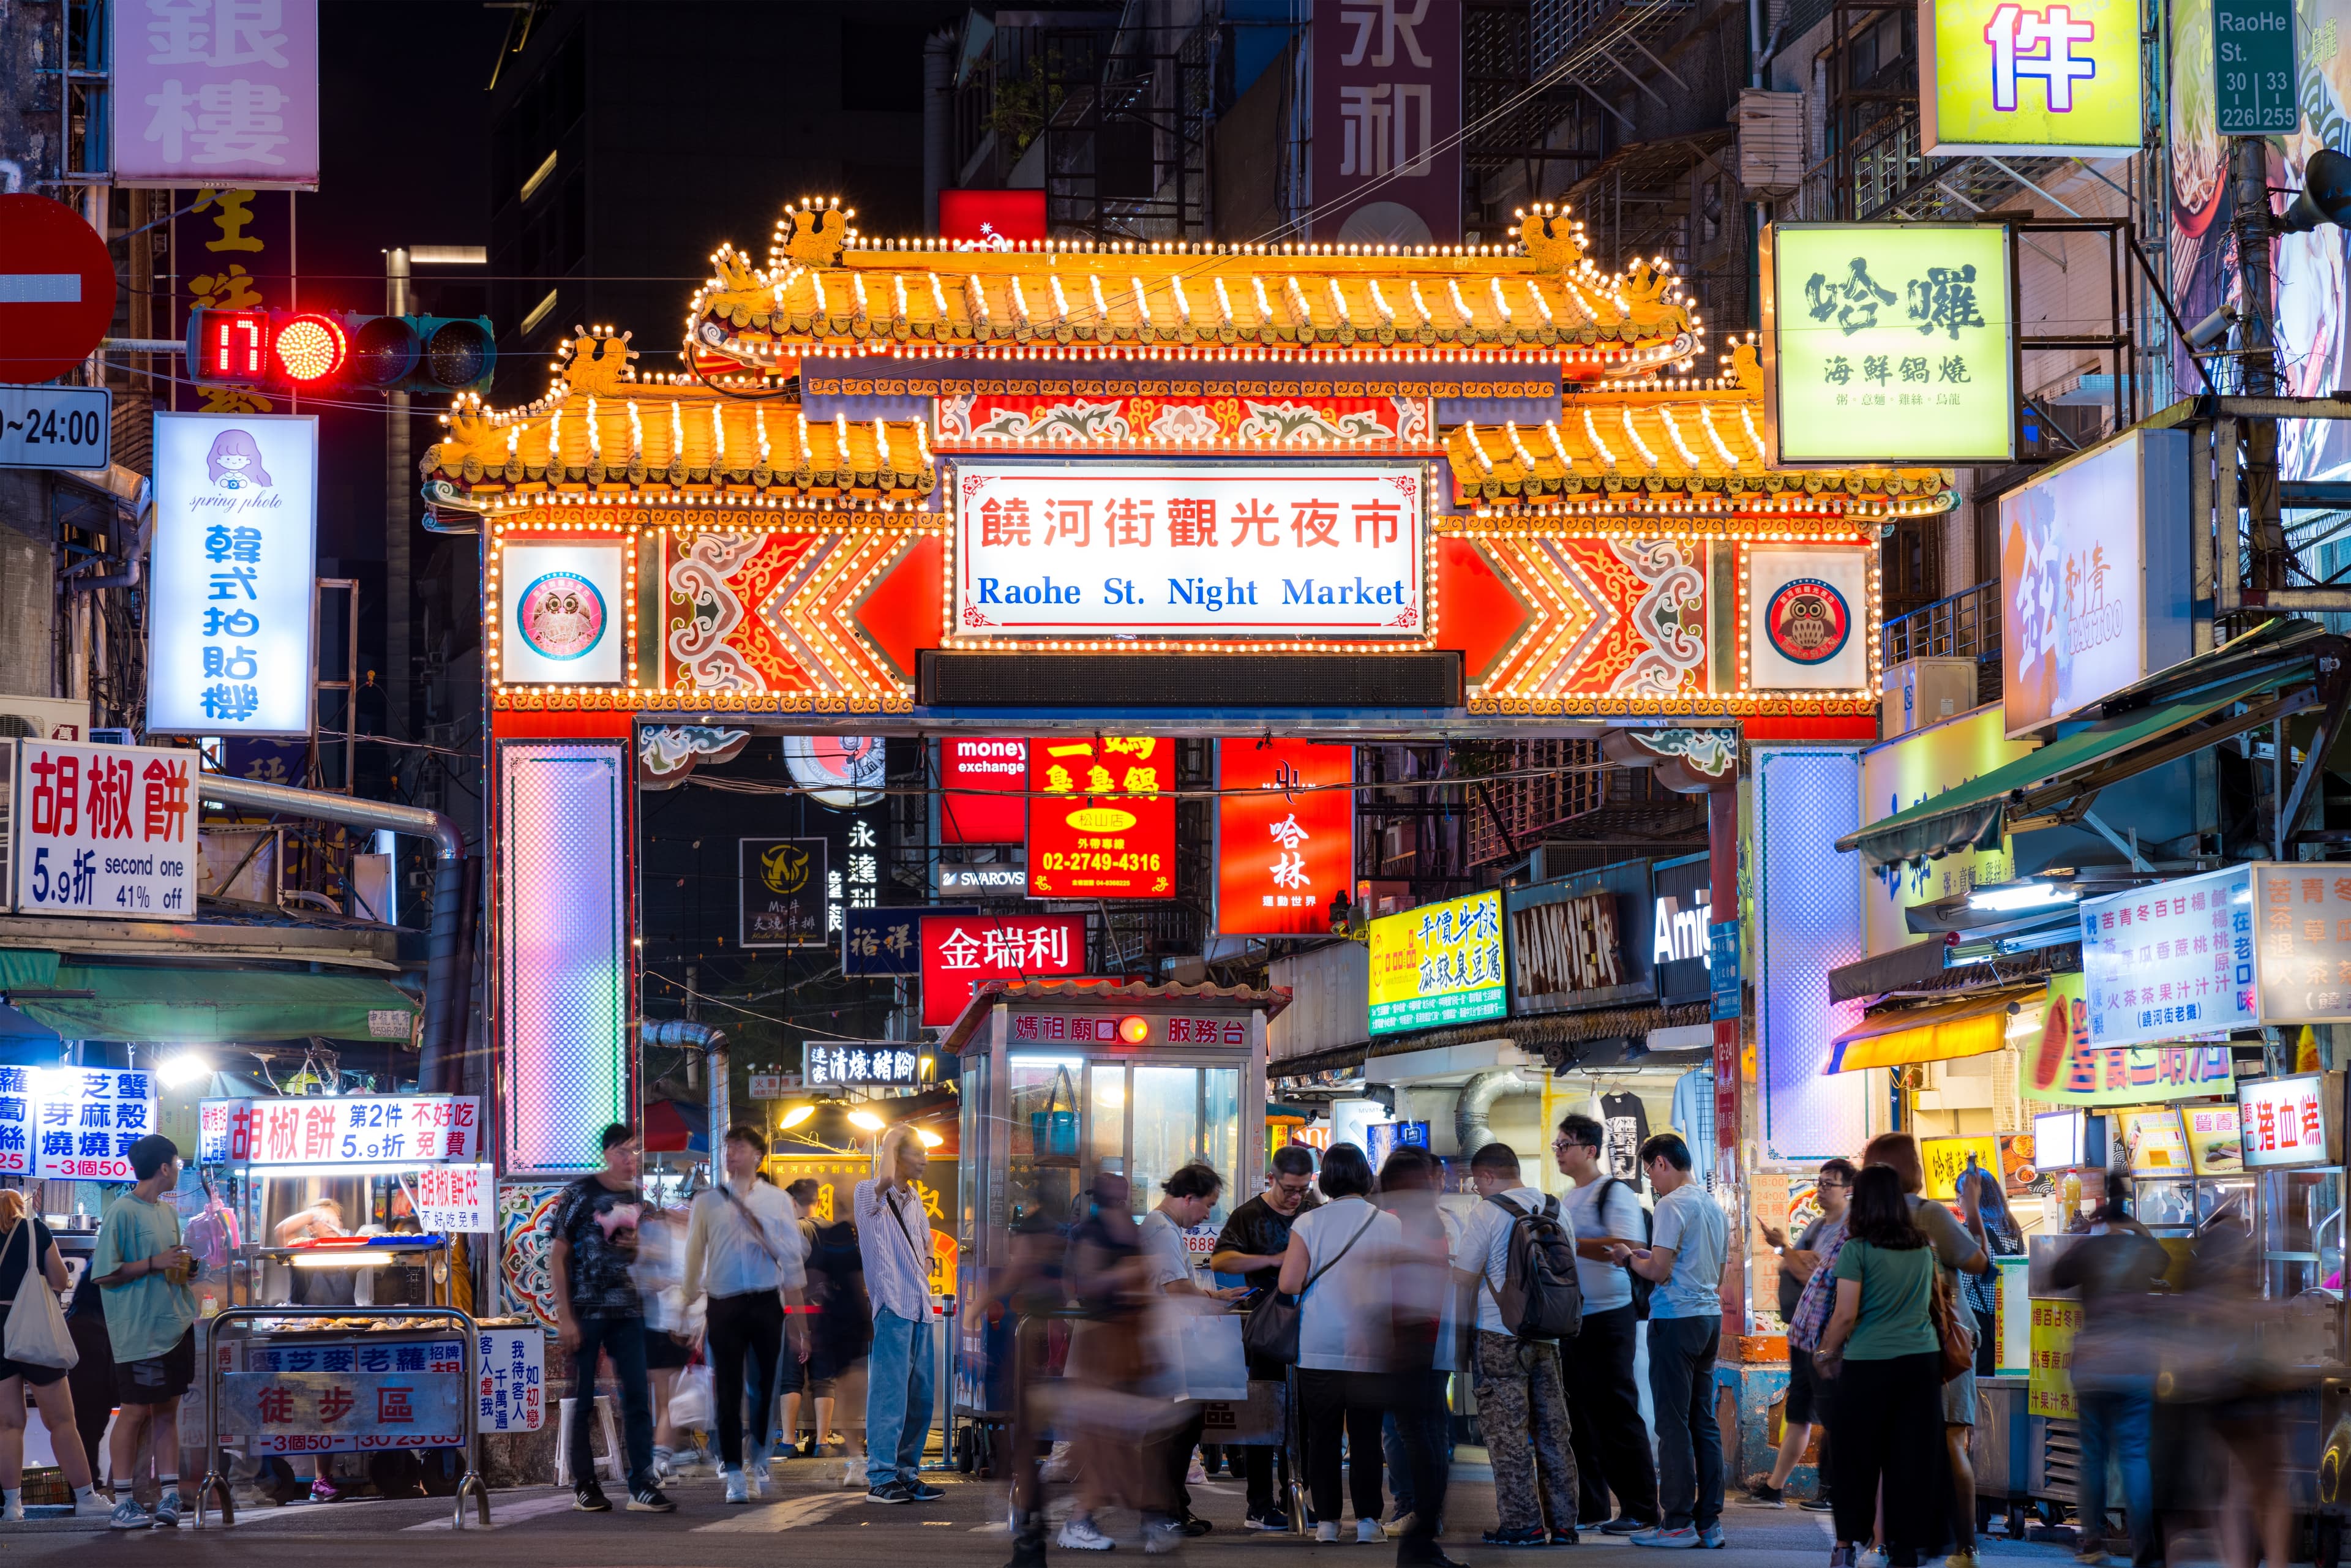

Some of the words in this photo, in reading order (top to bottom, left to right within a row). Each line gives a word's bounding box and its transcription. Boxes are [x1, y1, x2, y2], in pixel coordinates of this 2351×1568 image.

[2219, 12, 2286, 31] RaoHe
[1984, 3, 2095, 113] 件
[2221, 42, 2246, 61] St.
[144, 0, 290, 165] 銀樓
[1341, 0, 1432, 177] 永和
[2226, 72, 2246, 91] 30
[2267, 72, 2287, 90] 33
[2223, 108, 2254, 126] 226
[2263, 108, 2294, 126] 255
[219, 320, 258, 372] 17
[1825, 354, 1971, 387] 海鮮鍋燒
[189, 493, 238, 512] spring
[238, 490, 283, 513] photo
[980, 497, 1402, 549] 饒河街觀光夜市
[978, 576, 1081, 605] Raohe
[1104, 577, 1144, 605] St.
[1168, 576, 1259, 612] Night
[1281, 577, 1405, 606] Market
[2064, 540, 2110, 612] 刺青
[200, 525, 262, 721] 韓式拍貼機
[2068, 599, 2123, 655] TATTOO
[958, 742, 1025, 760] money
[958, 761, 1025, 775] exchange
[31, 751, 189, 842] 胡椒餅
[1043, 765, 1160, 801] 臭臭鍋
[1079, 813, 1124, 828] 松山店
[105, 854, 152, 876] second
[160, 861, 183, 877] one
[1043, 852, 1160, 871] 02-2749-4316
[1269, 813, 1310, 890] 哈林
[32, 847, 96, 905] 5.9折
[961, 871, 1025, 886] SWAROVS
[116, 885, 149, 908] 41%
[163, 887, 182, 909] off
[1262, 896, 1316, 907] 運動世界
[1418, 897, 1498, 947] 平價牛排
[2302, 878, 2328, 985] 青草茶
[938, 925, 1068, 970] 金瑞利
[1419, 942, 1500, 992] 麻辣臭豆腐
[1015, 1015, 1117, 1042] 媽祖廟口
[1168, 1018, 1245, 1045] 服務台
[79, 1073, 111, 1157] 芝麻燒
[231, 1105, 336, 1161] 胡椒餅
[350, 1103, 402, 1128] 第2件
[411, 1103, 474, 1128] 不好吃
[341, 1133, 405, 1158] 5.9折
[416, 1131, 465, 1157] 免費
[1757, 1178, 1784, 1187] 16:00
[1757, 1191, 1785, 1201] 24:00
[421, 1210, 479, 1228] 不好吃免費
[430, 1345, 459, 1360] 招牌
[480, 1335, 493, 1416] 客人虐我
[512, 1340, 525, 1420] 我待客人
[257, 1386, 414, 1425] 徒步區
[495, 1368, 508, 1429] 千萬遍
[526, 1365, 539, 1429] 如初戀
